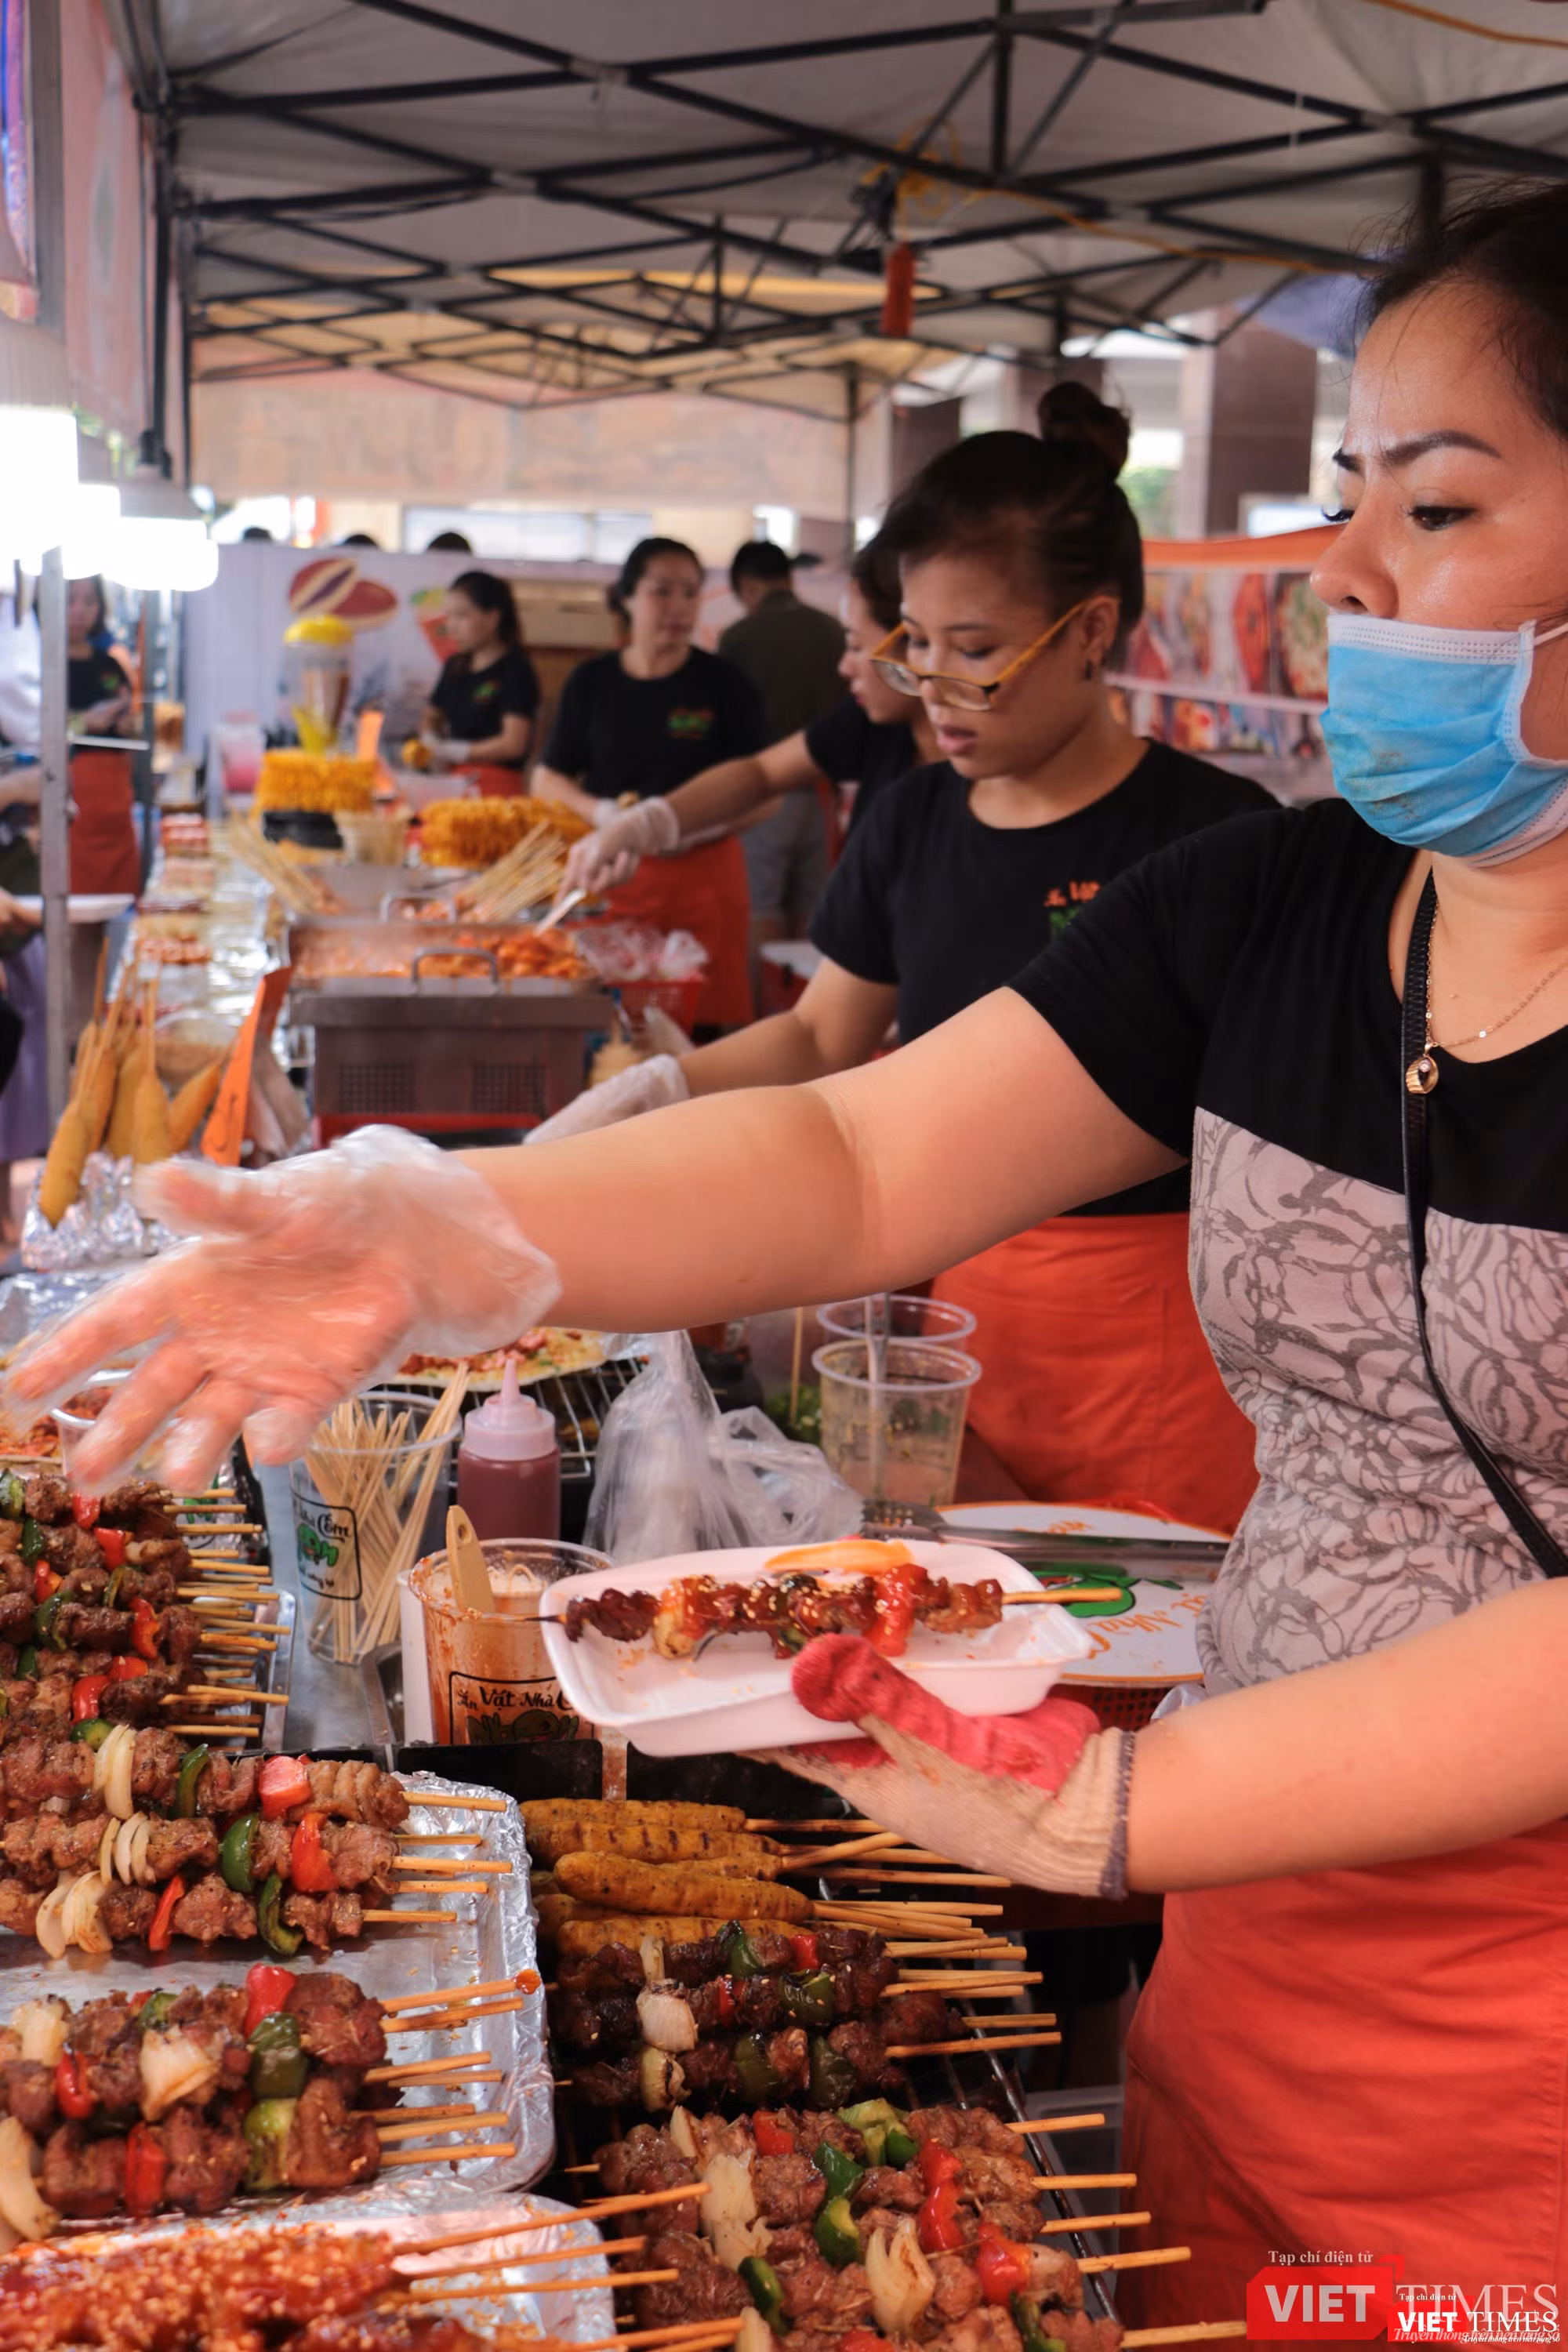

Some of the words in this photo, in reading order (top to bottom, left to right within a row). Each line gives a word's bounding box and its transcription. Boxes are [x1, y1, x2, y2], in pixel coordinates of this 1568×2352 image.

[457, 1689, 477, 1711] Ăn
[479, 1686, 515, 1711] Vặt
[520, 1691, 554, 1708] Nhà
